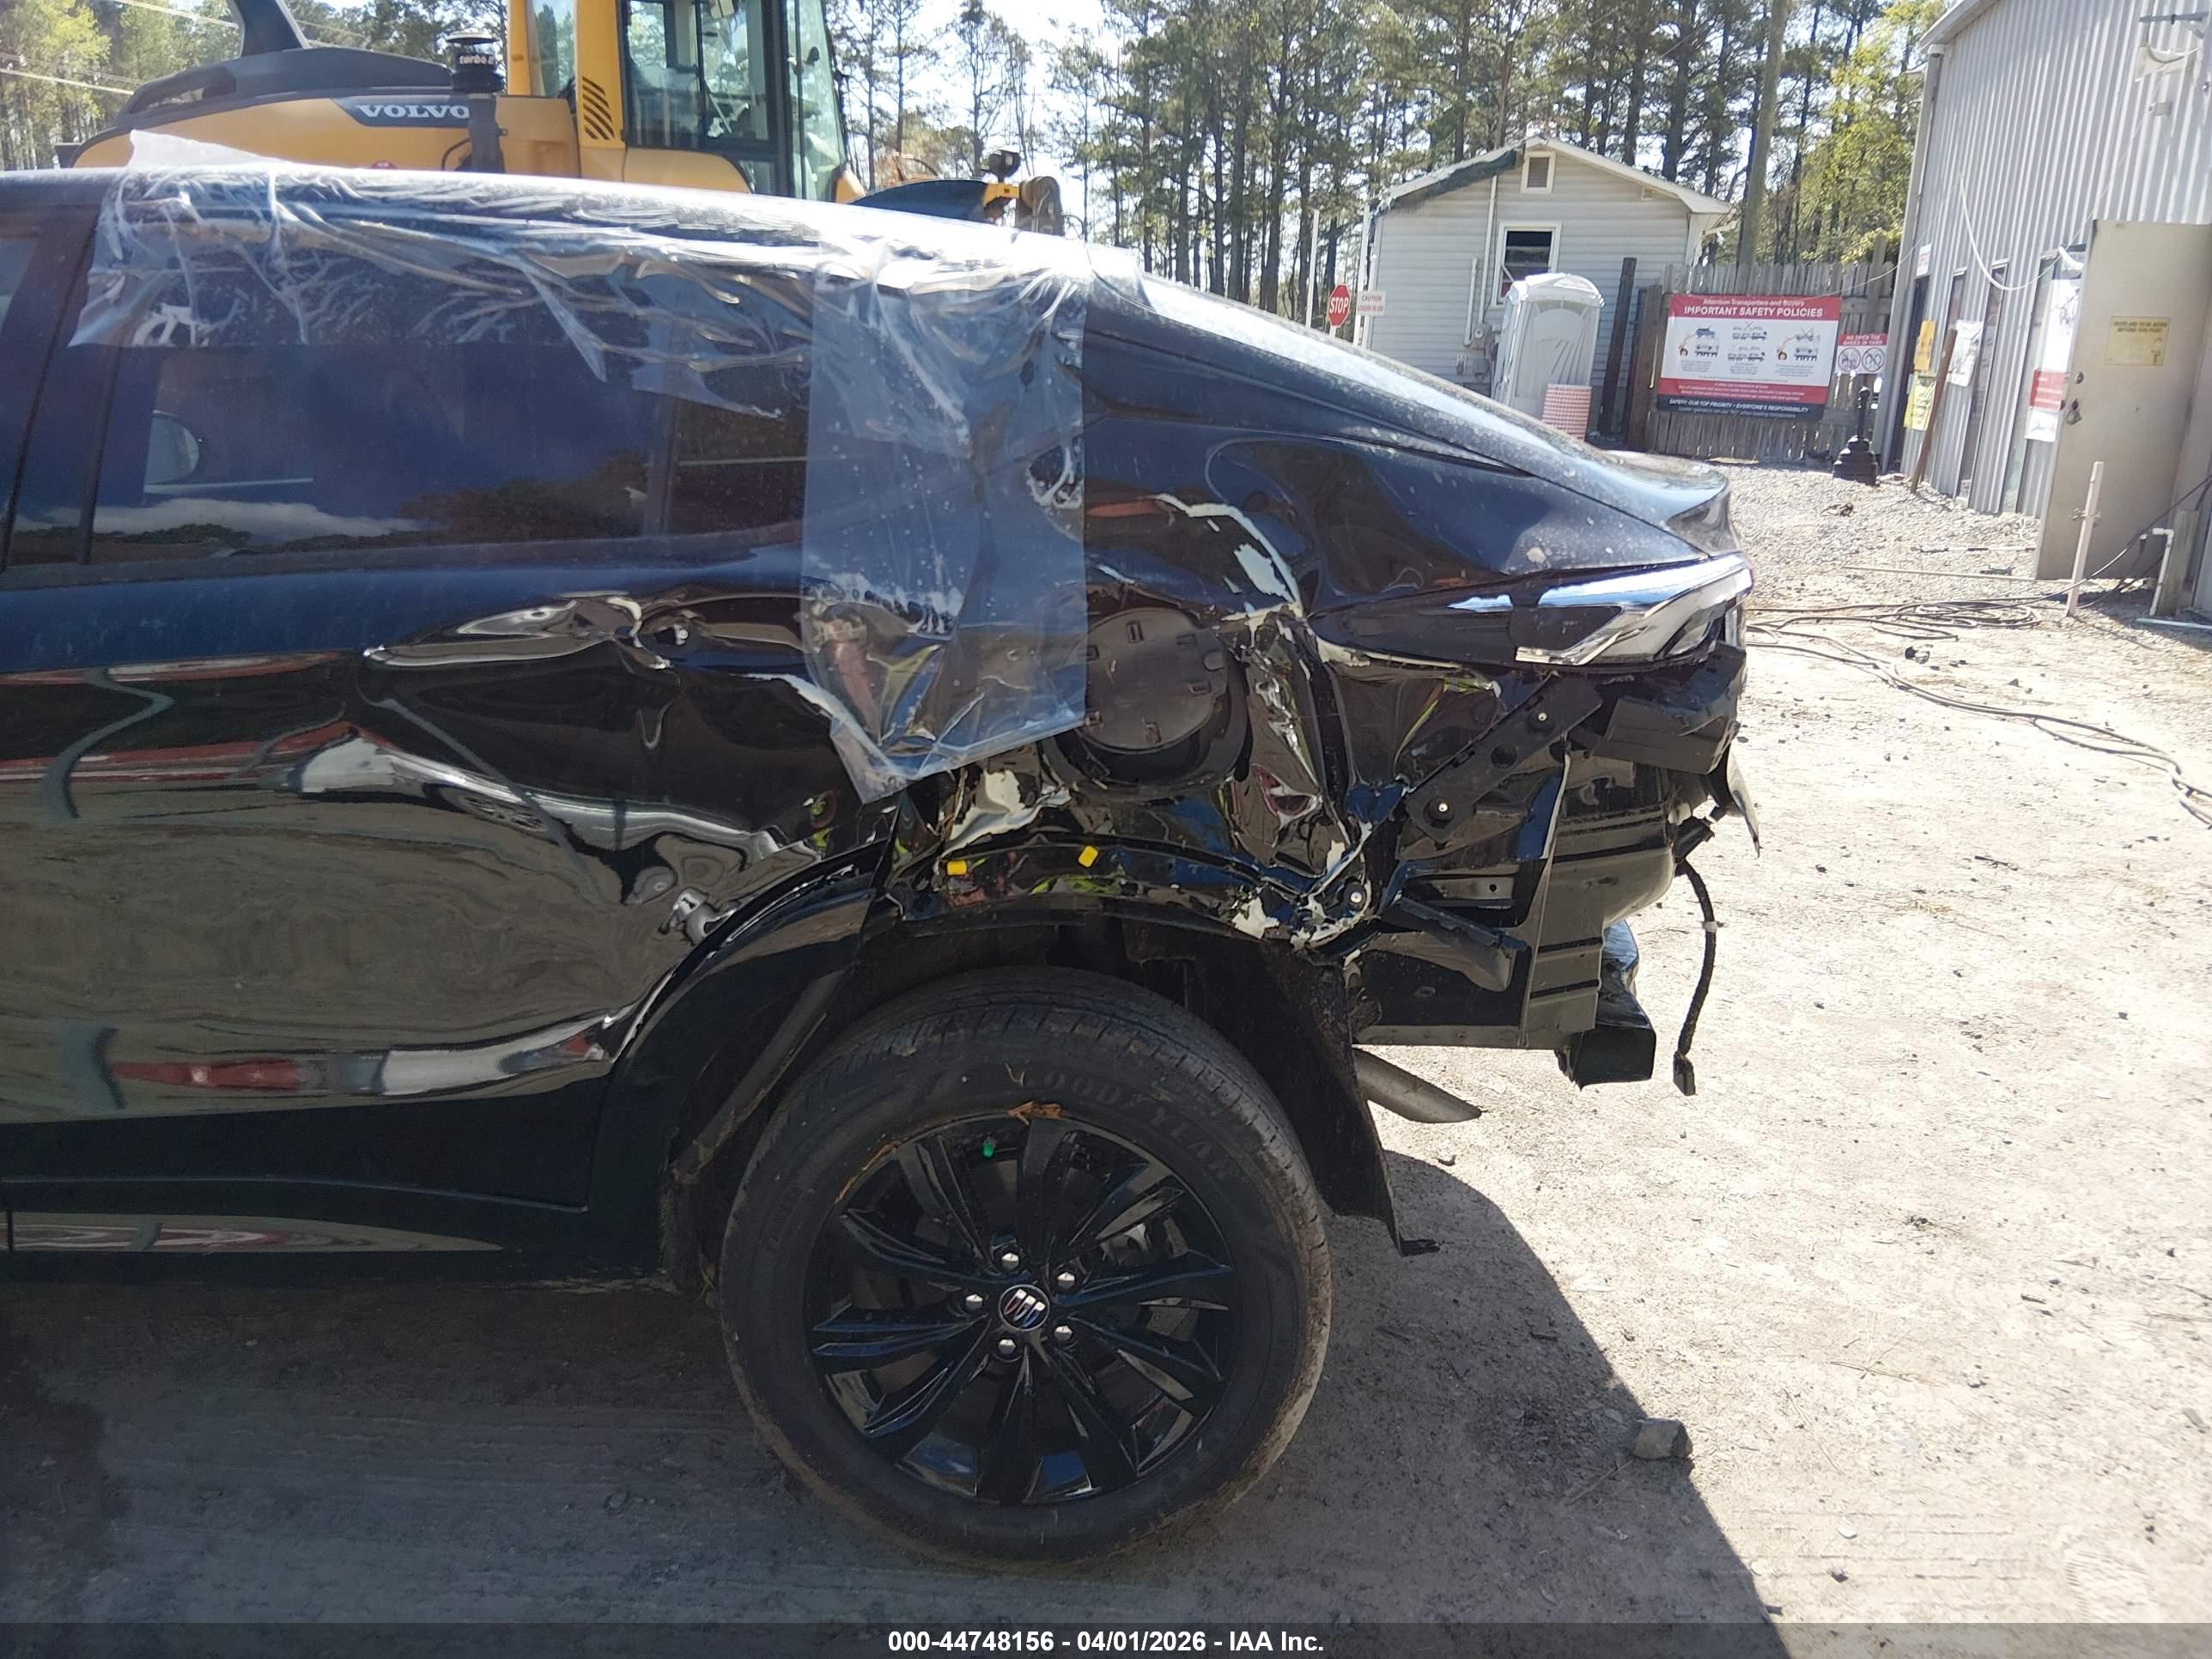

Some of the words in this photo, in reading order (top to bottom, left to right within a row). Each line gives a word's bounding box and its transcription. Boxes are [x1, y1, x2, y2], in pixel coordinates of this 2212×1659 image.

[356, 105, 470, 118] VOLVO
[1329, 297, 1349, 314] STOP
[1684, 306, 1737, 315] IMPORTANT
[1739, 307, 1775, 316] SAFETY
[1776, 307, 1823, 317] POLICIES
